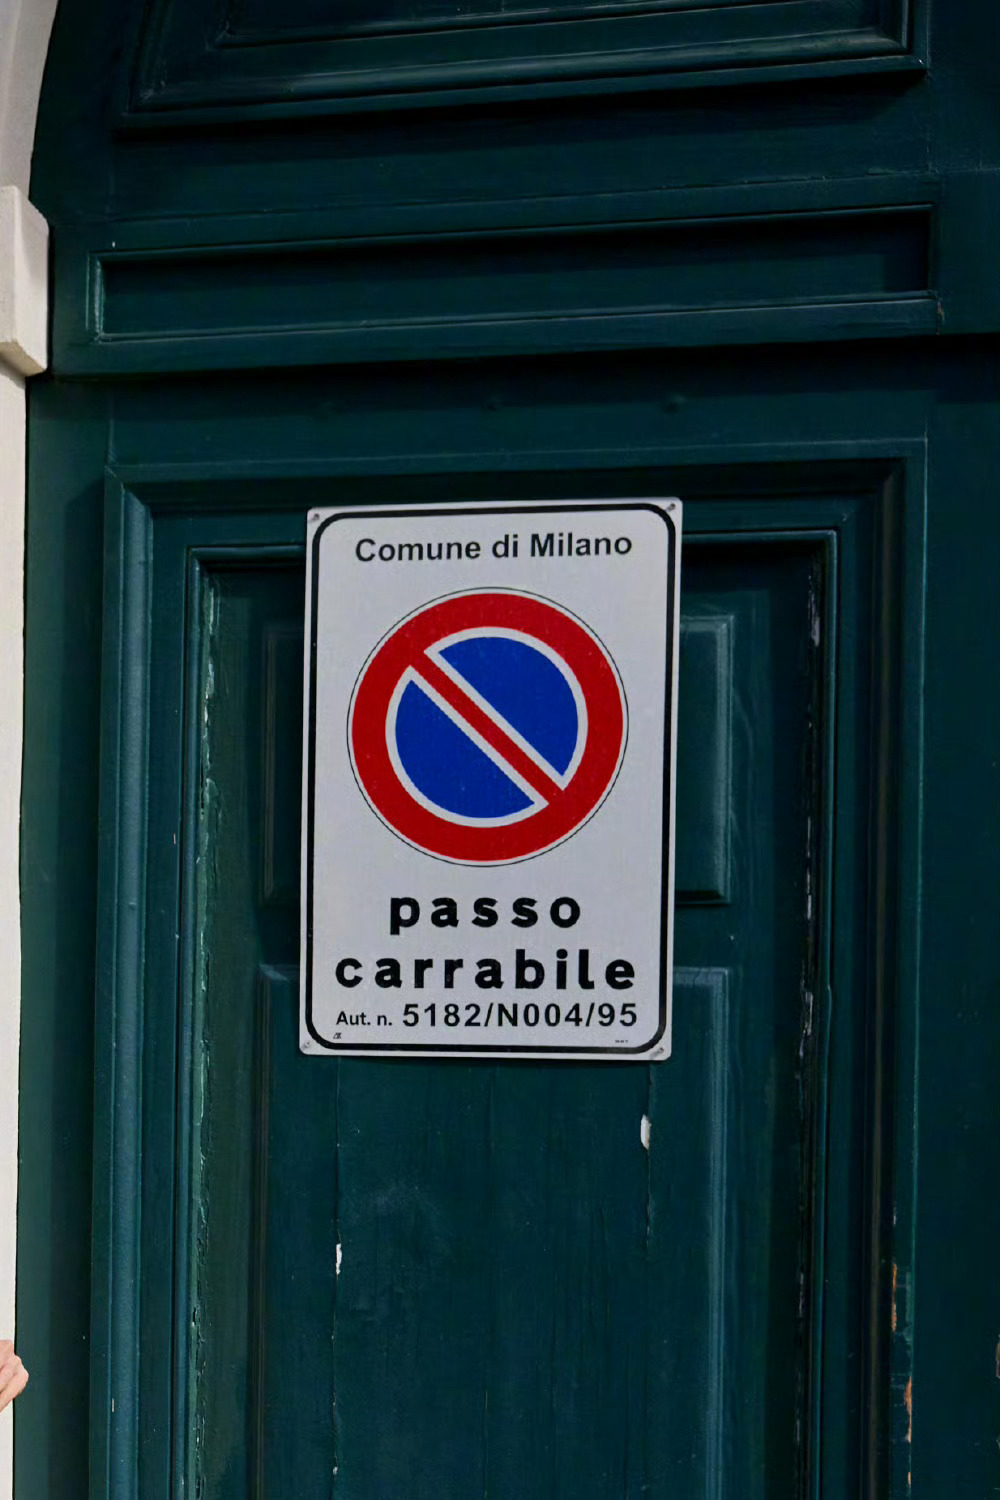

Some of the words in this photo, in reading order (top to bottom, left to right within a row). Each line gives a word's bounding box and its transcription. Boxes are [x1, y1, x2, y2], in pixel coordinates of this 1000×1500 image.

[355, 538, 481, 562] Comune
[491, 533, 519, 559] di
[530, 532, 633, 558] Milano
[389, 896, 581, 936] passo
[334, 948, 636, 991] carrabile
[335, 1010, 371, 1026] Aut.
[376, 1014, 393, 1027] n.
[402, 1002, 638, 1028] 5182/N004/95
